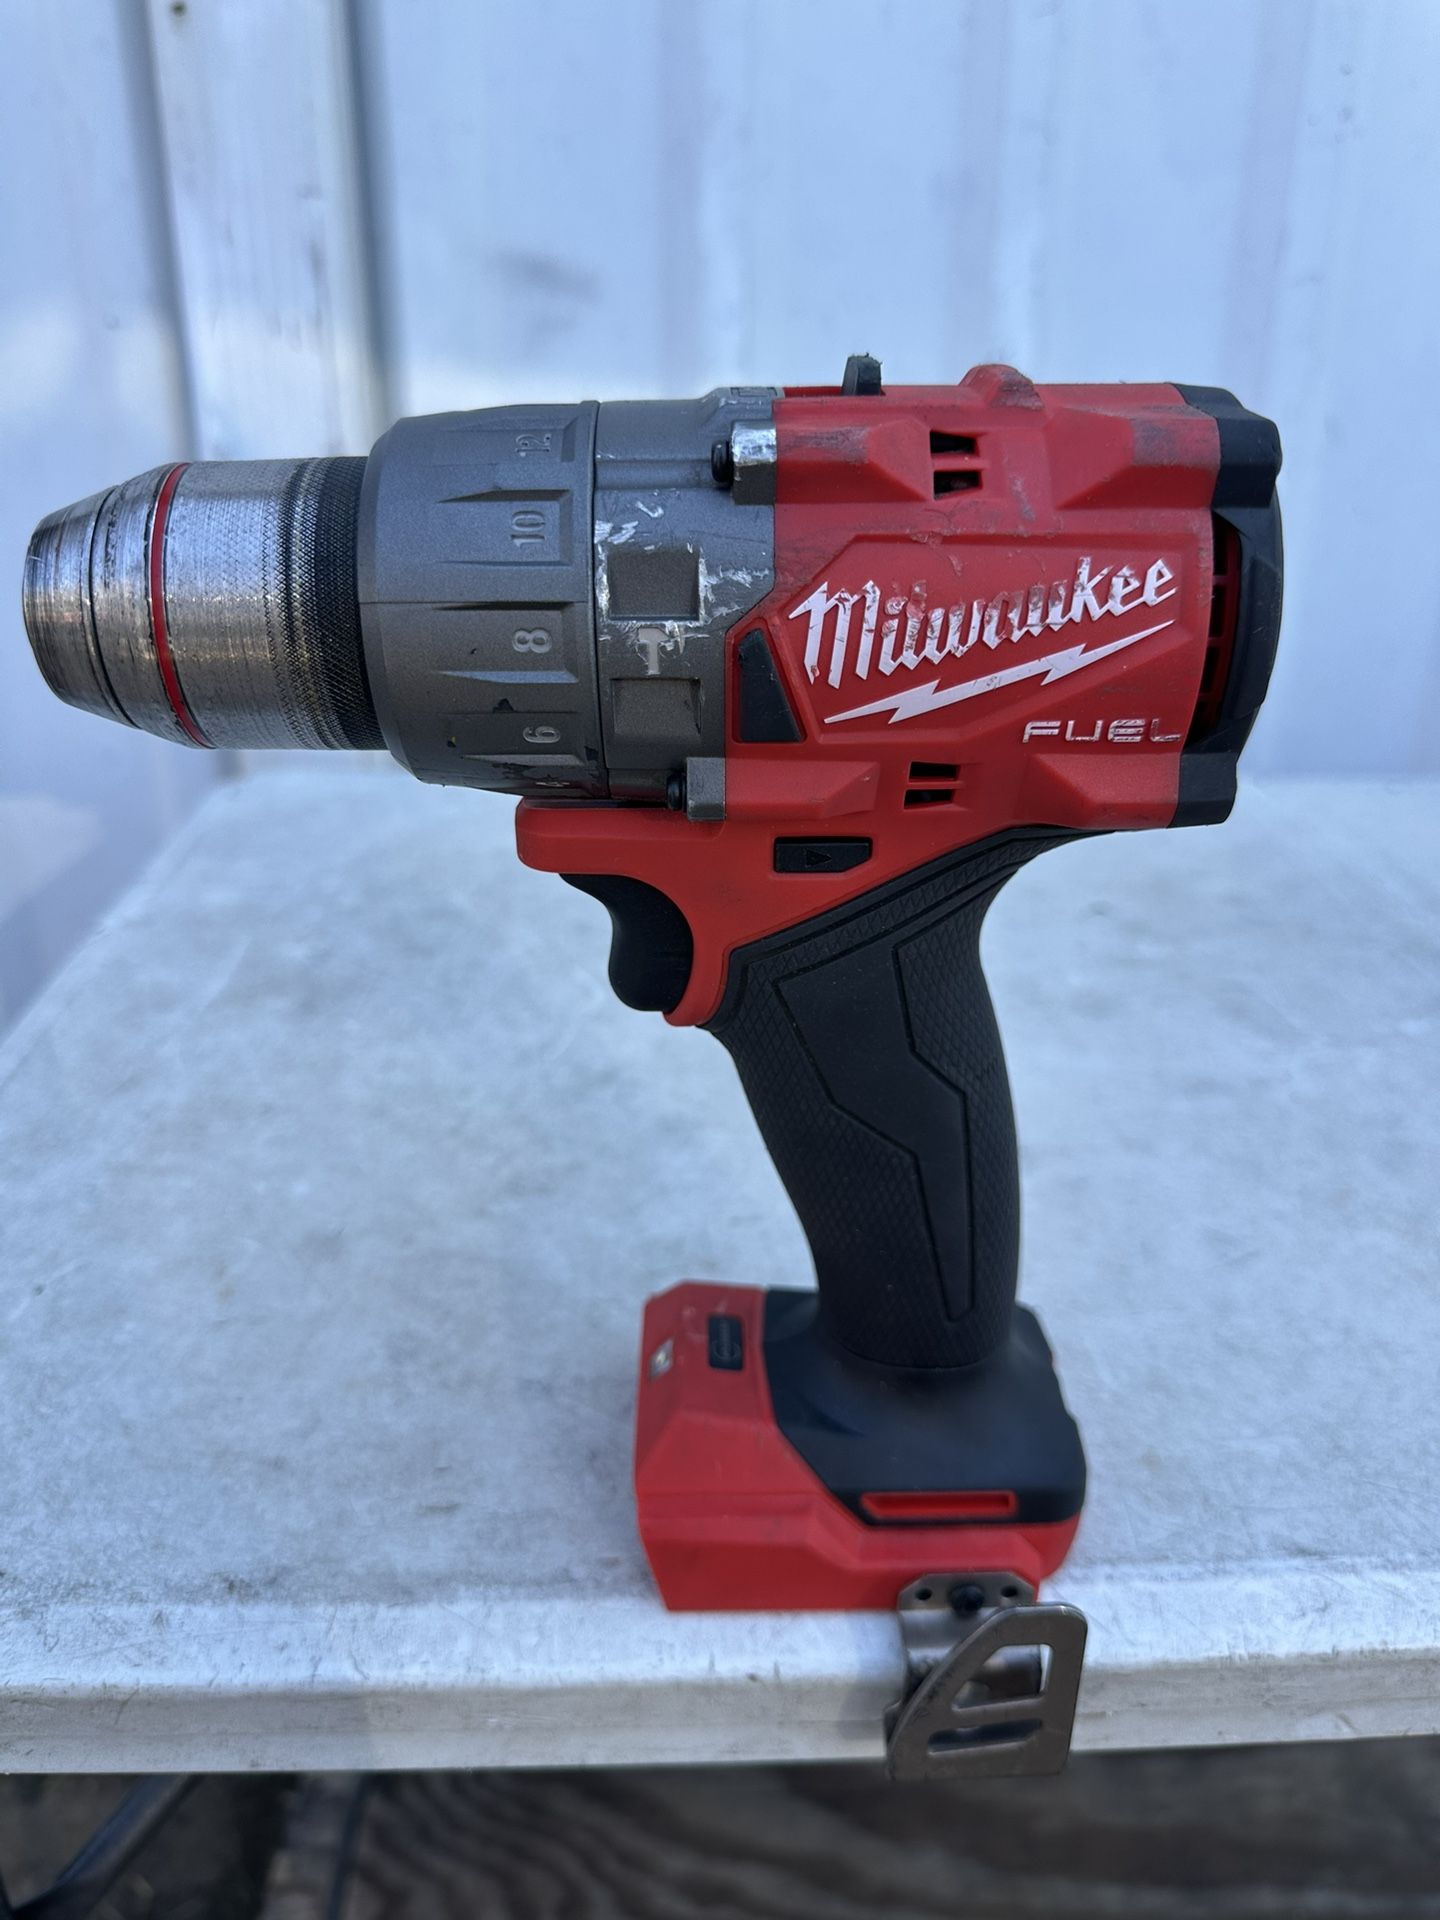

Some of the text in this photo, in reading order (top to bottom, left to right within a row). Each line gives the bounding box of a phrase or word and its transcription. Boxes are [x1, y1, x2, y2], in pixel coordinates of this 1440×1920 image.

[511, 510, 546, 547] 10
[789, 556, 1177, 689] Milwaukee
[512, 627, 553, 655] 8
[523, 726, 560, 743] 6
[1022, 718, 1181, 743] FUEL
